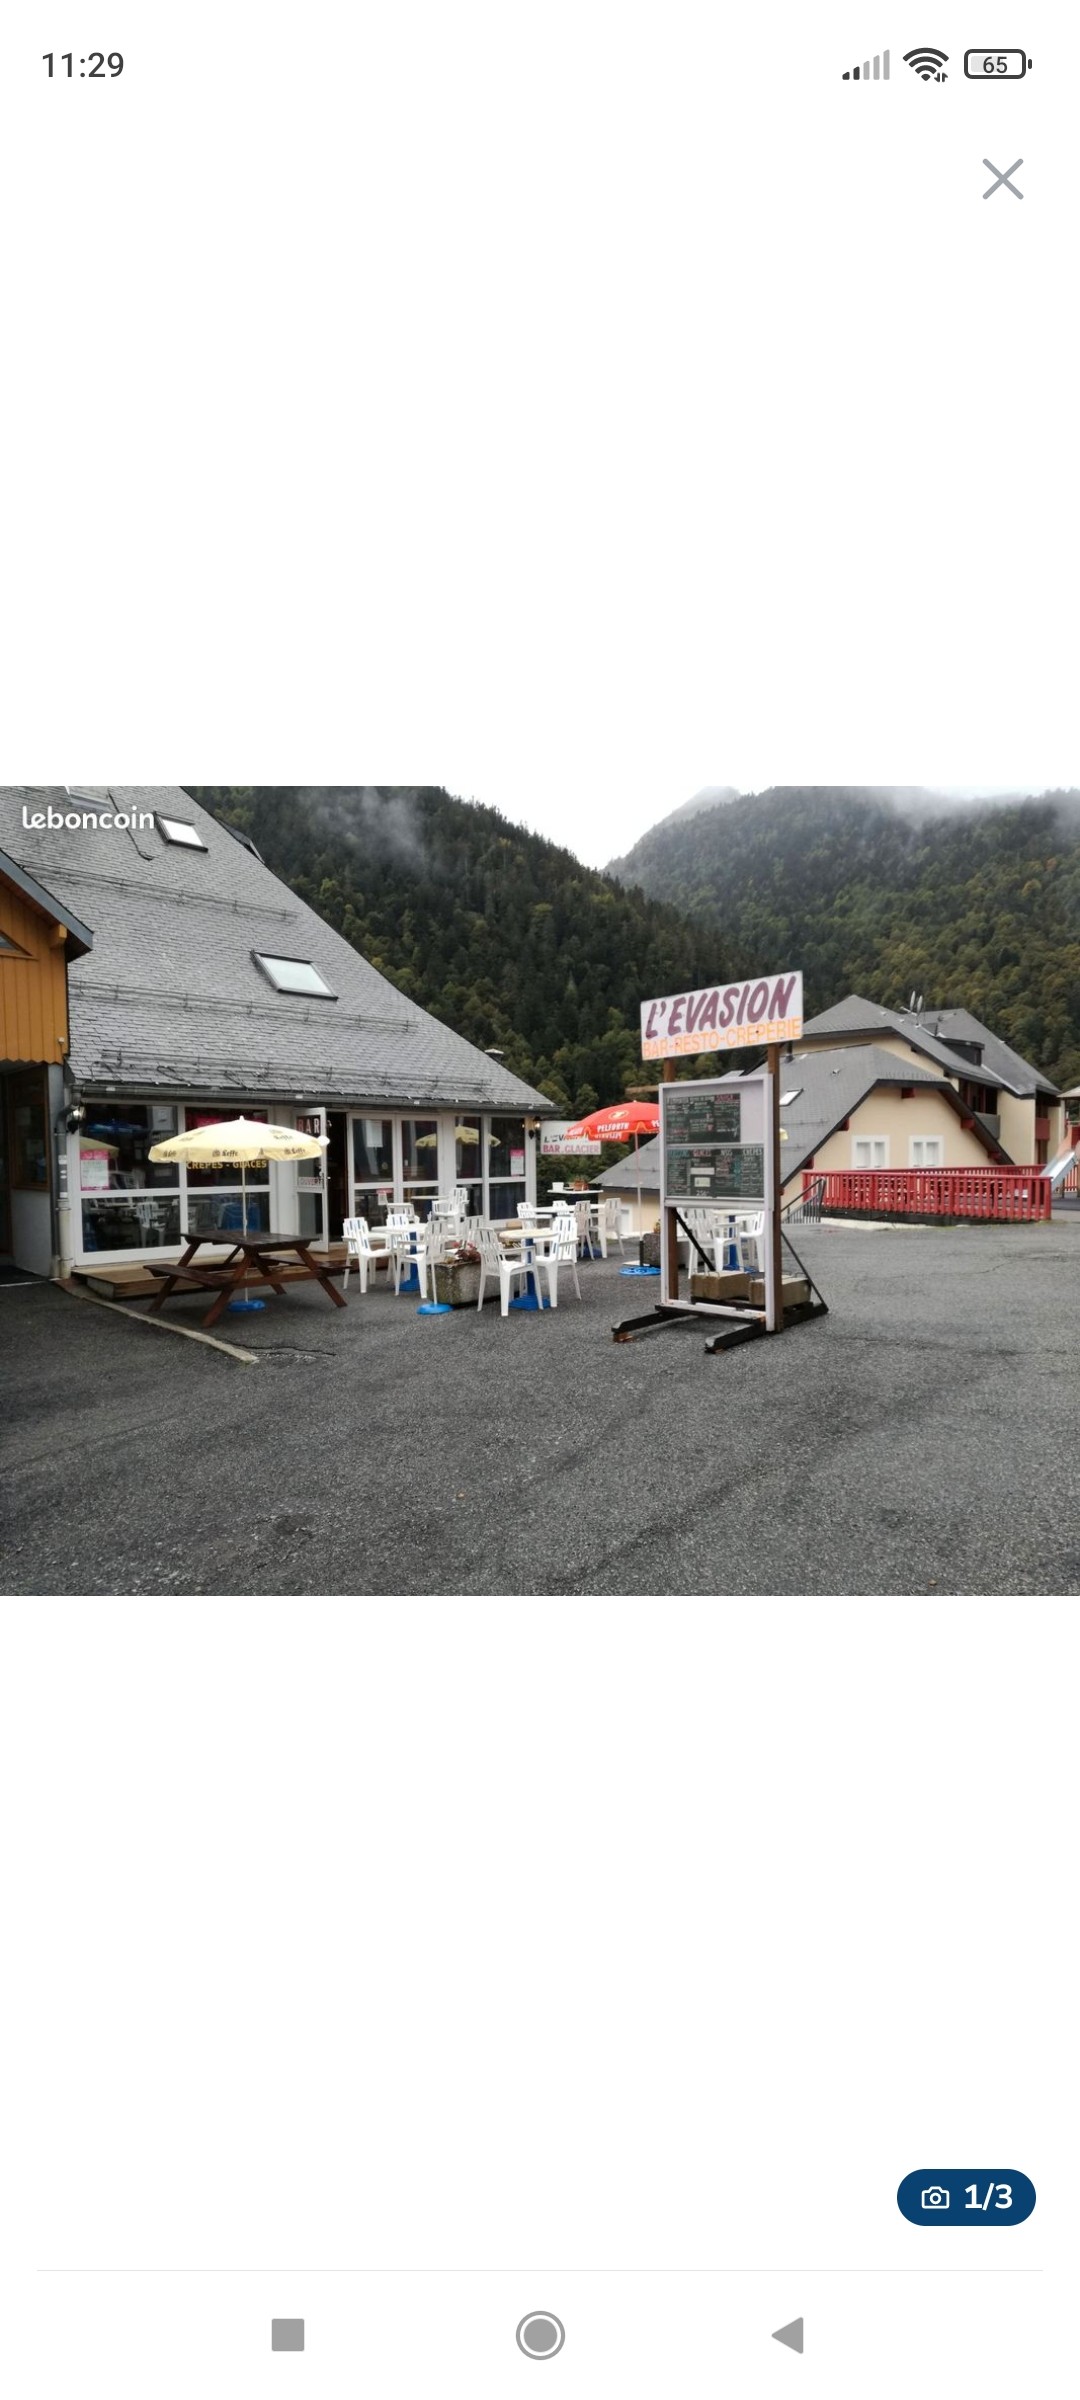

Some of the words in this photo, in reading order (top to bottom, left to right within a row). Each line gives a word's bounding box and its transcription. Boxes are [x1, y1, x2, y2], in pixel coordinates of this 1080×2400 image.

[645, 975, 797, 1040] L'EVASION
[297, 1118, 320, 1134] BAR
[543, 1144, 561, 1153] BAR
[564, 1144, 600, 1153] GLACIER
